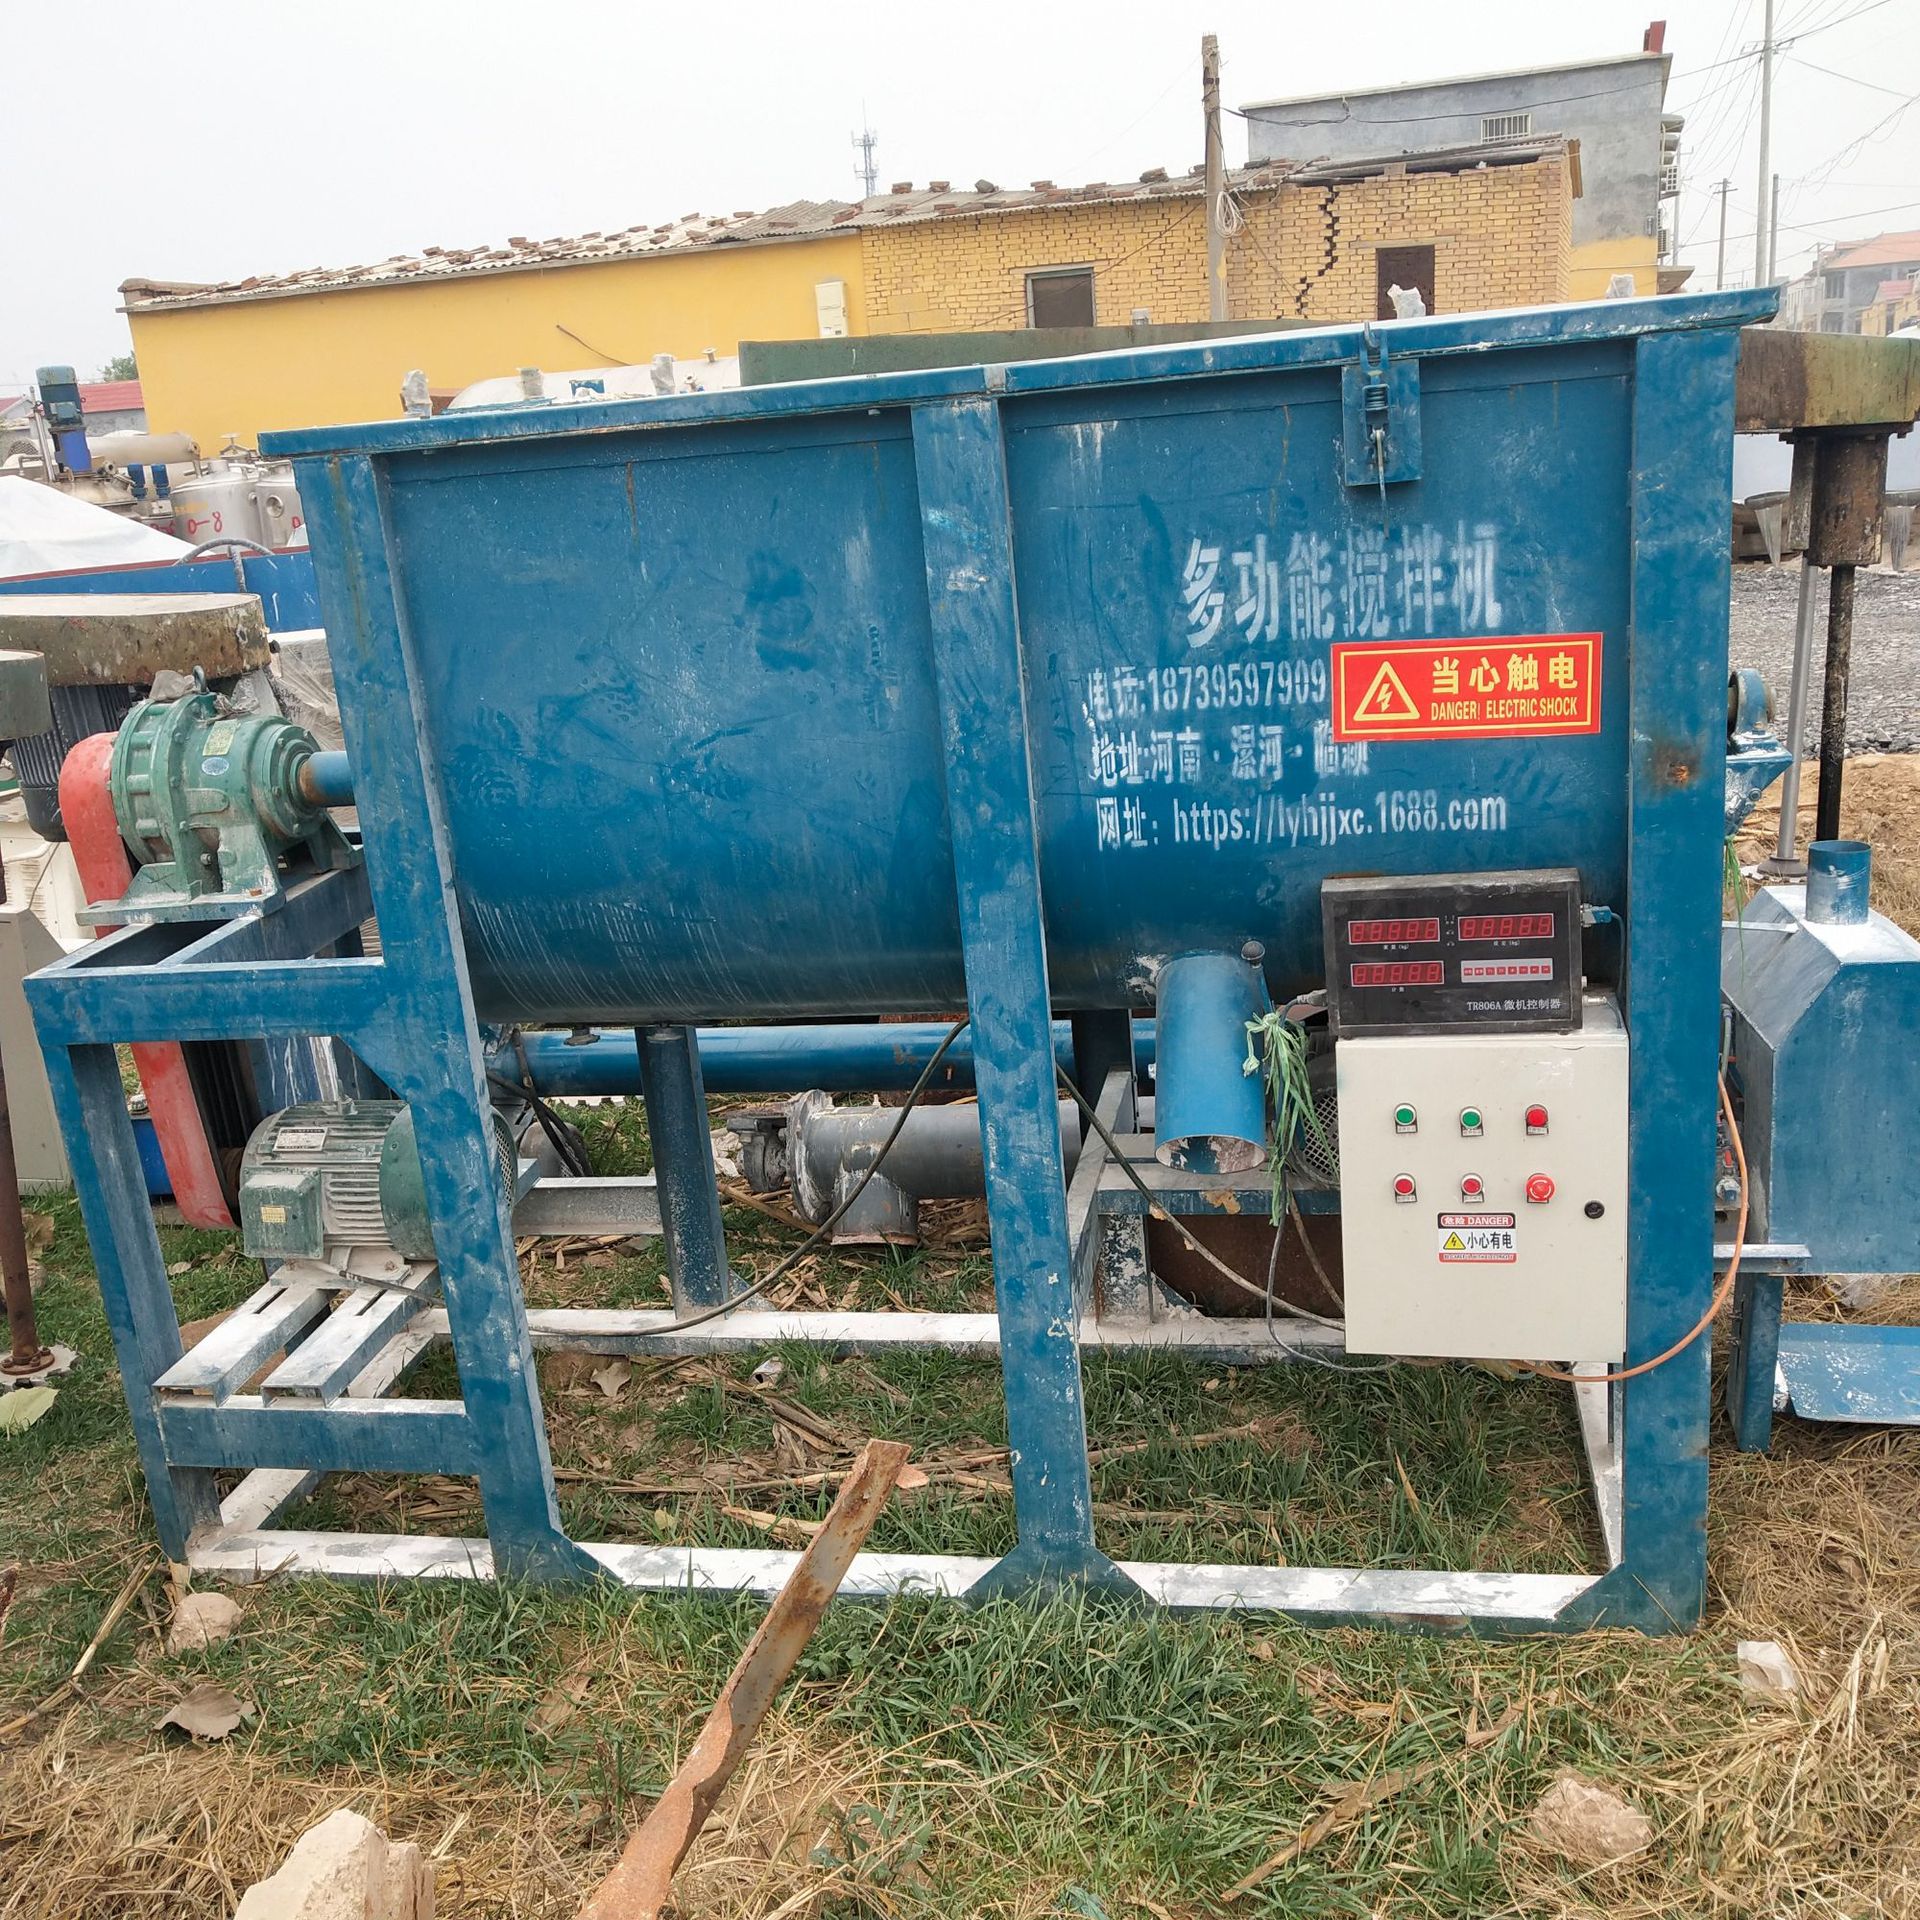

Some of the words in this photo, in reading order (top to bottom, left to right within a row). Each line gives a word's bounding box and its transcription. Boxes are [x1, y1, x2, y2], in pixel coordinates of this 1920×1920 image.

[1184, 520, 1501, 648] 多功能搅拌机
[1432, 652, 1578, 695] 当心触电
[1431, 702, 1481, 721] DANGER!
[1486, 698, 1537, 719] ELECTRIC
[1540, 697, 1578, 717] SHOCK
[1467, 1001, 1501, 1011] TR806A
[1504, 998, 1561, 1011] 微机控制器
[1468, 1216, 1509, 1225] DANGER
[1467, 1232, 1513, 1249] 小心有电
